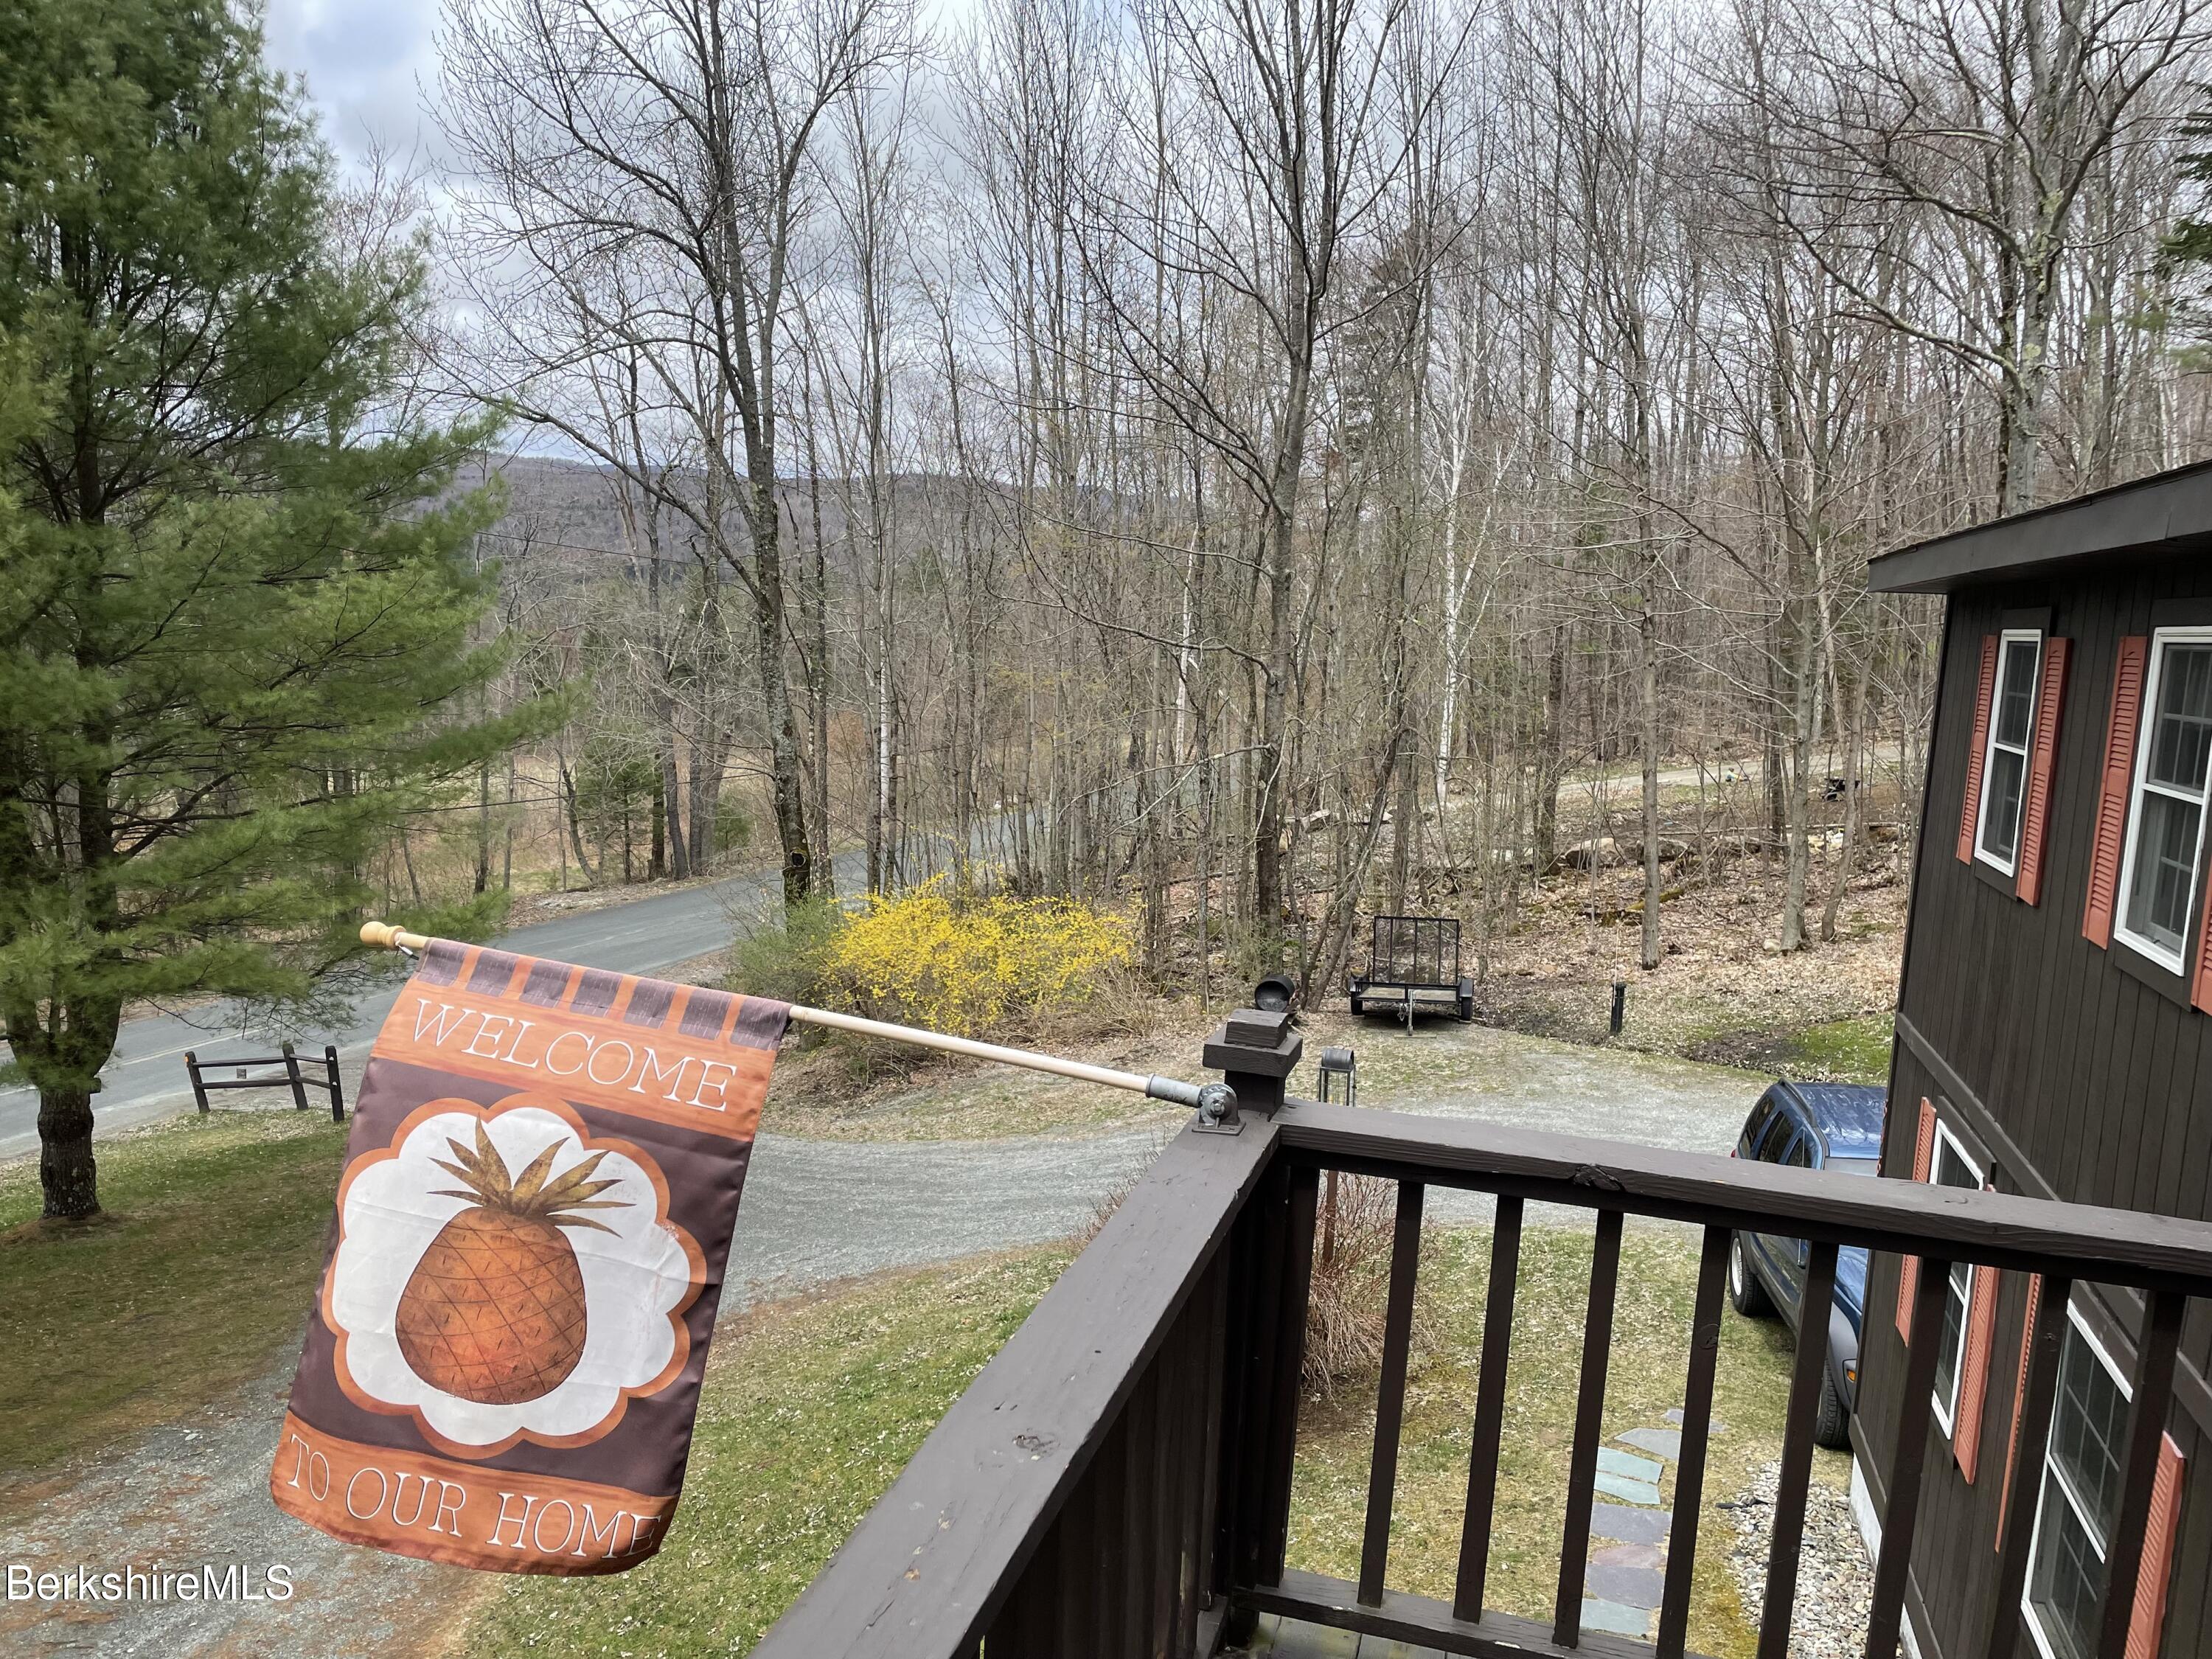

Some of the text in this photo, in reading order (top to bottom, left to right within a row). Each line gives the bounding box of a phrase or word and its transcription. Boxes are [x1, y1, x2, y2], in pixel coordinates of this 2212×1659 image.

[413, 998, 737, 1112] WELCOME
[287, 1433, 662, 1559] TO OUR HOME
